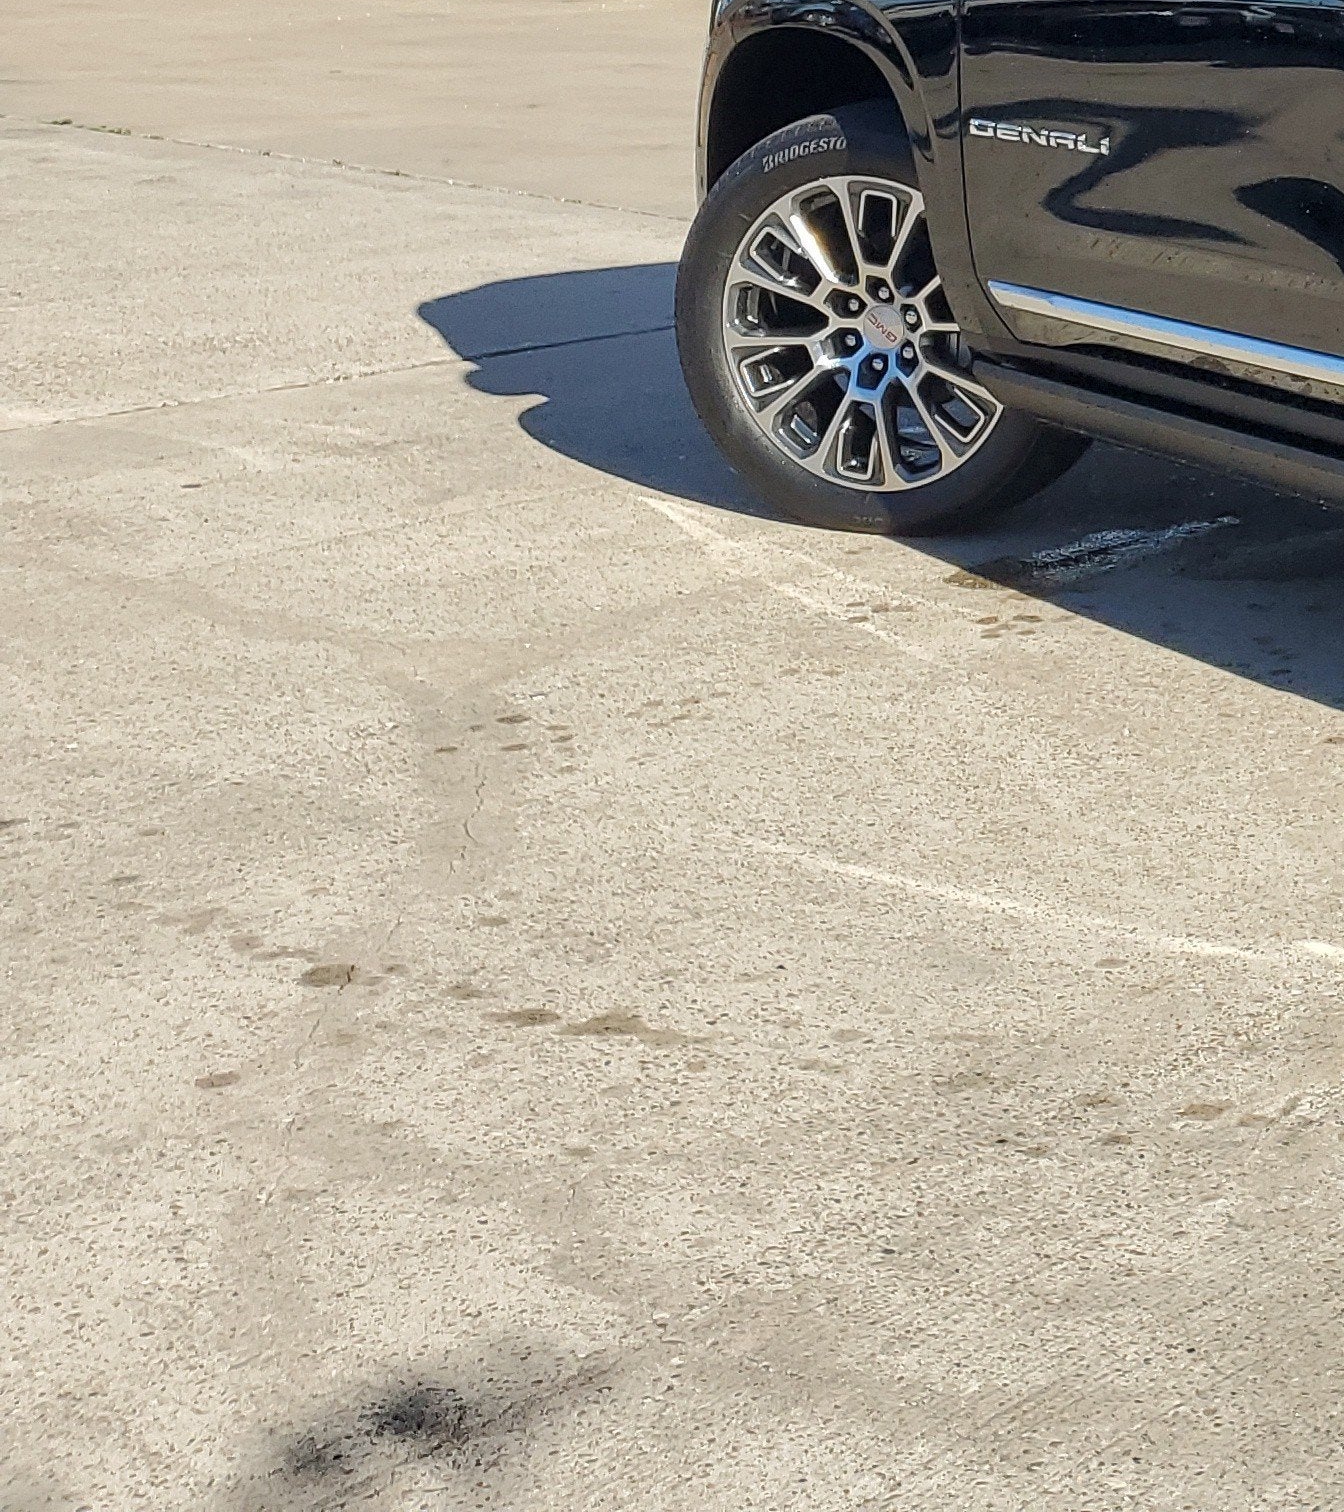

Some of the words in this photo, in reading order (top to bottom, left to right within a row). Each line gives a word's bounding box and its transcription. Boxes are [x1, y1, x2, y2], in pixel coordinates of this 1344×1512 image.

[761, 136, 847, 173] BRIDGESTO
[969, 118, 1110, 156] DENALI
[868, 312, 898, 343] GMC
